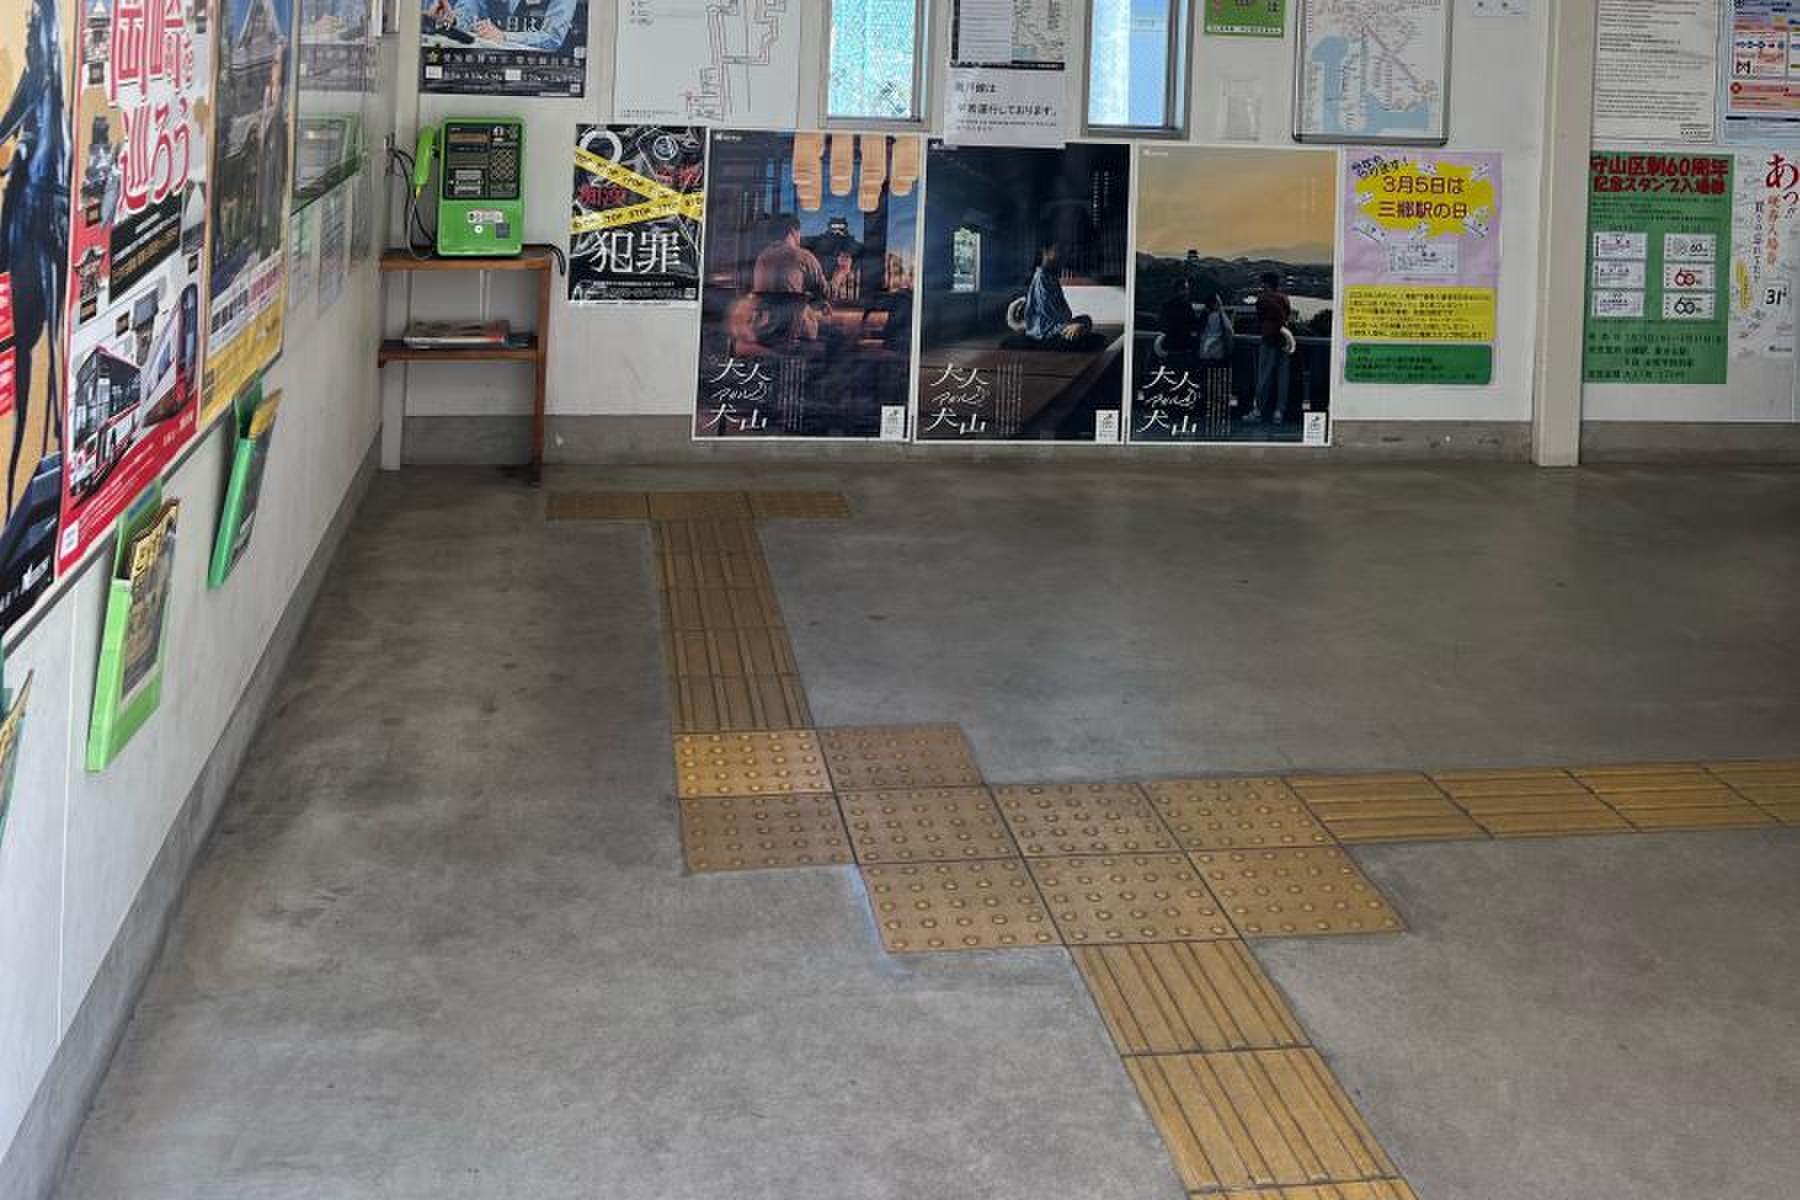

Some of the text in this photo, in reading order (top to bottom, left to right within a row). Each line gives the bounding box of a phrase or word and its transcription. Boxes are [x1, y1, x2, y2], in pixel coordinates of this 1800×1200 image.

[1383, 176, 1464, 194] 3月5日は
[1378, 200, 1467, 218] 三郷駅の日
[590, 231, 681, 272] 犯罪
